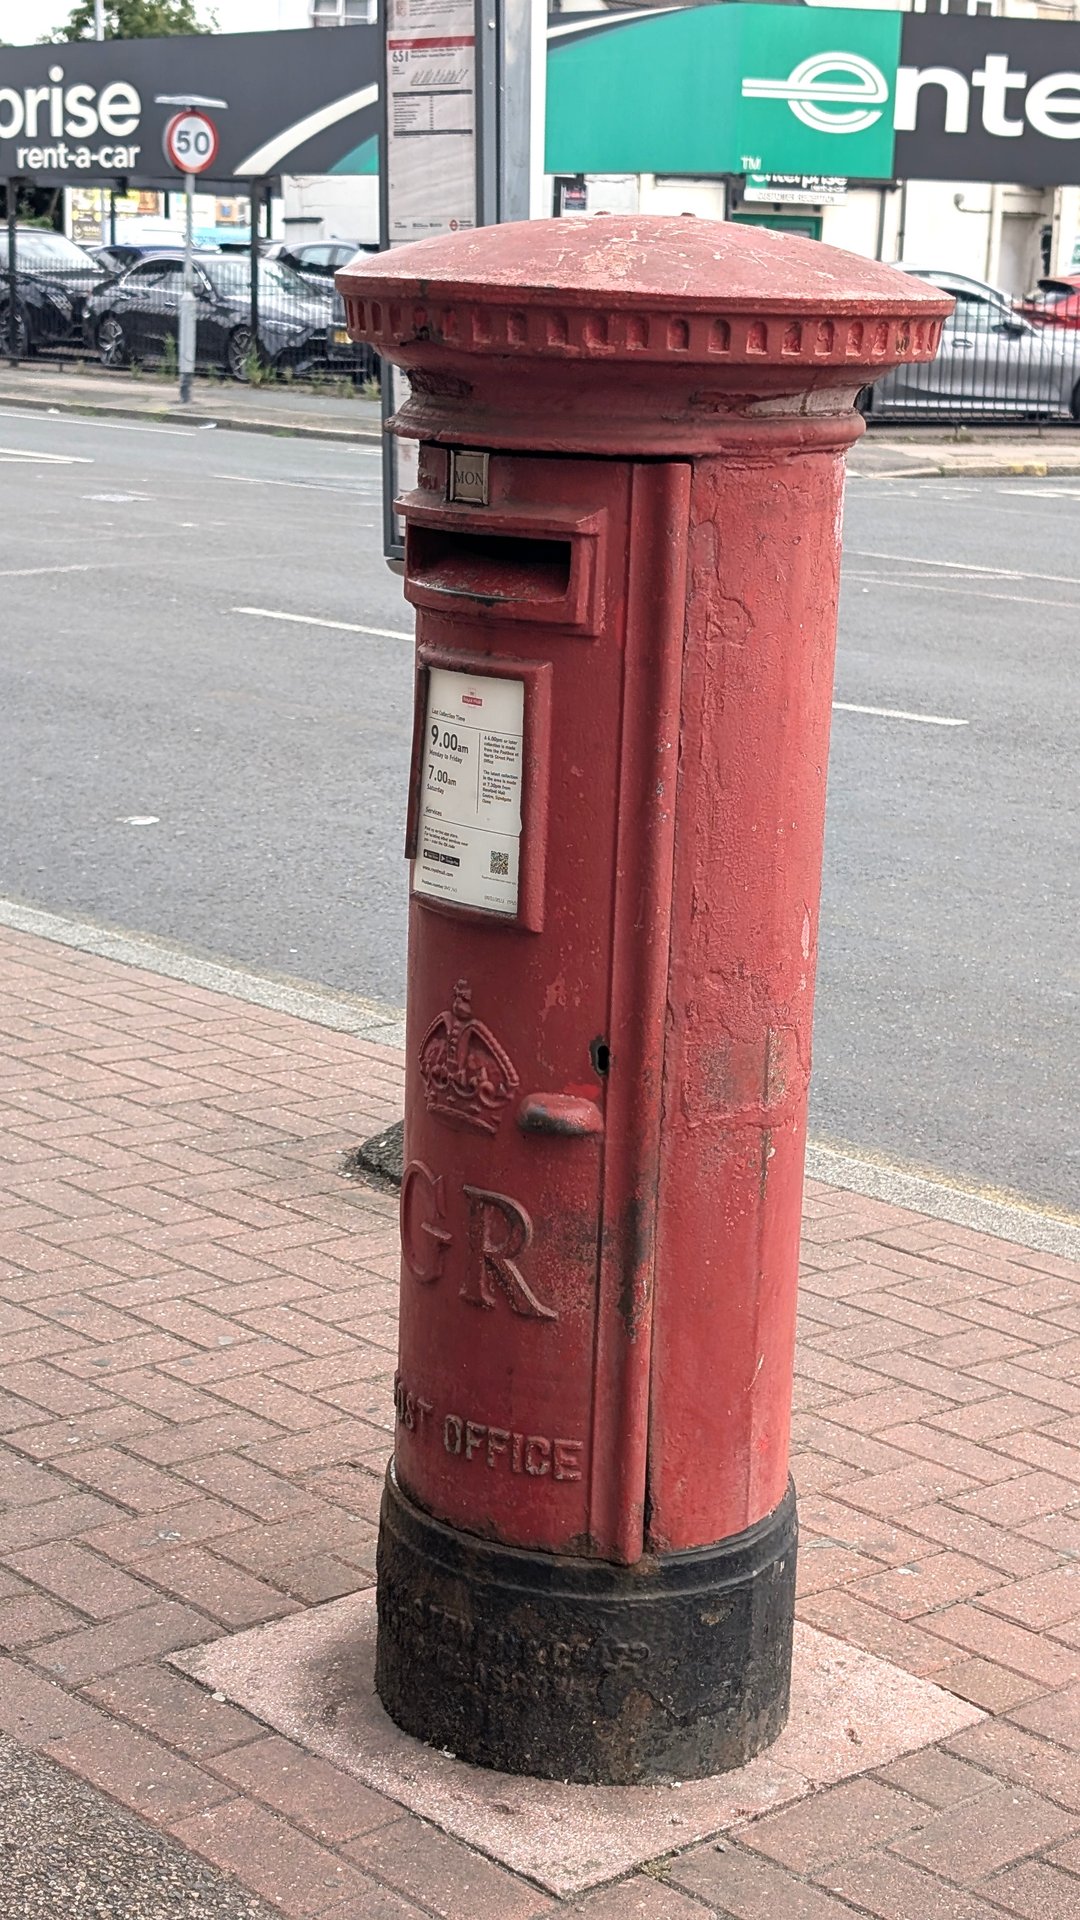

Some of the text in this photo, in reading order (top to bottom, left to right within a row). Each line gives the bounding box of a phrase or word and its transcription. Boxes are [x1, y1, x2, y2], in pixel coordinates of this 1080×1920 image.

[16, 142, 141, 169] rent-a-car
[176, 130, 210, 156] 50
[741, 156, 761, 170] TM
[455, 471, 484, 486] MON
[431, 724, 469, 754] 9.00am
[428, 764, 457, 786] 7.00am
[443, 1413, 584, 1482] OFFICE
